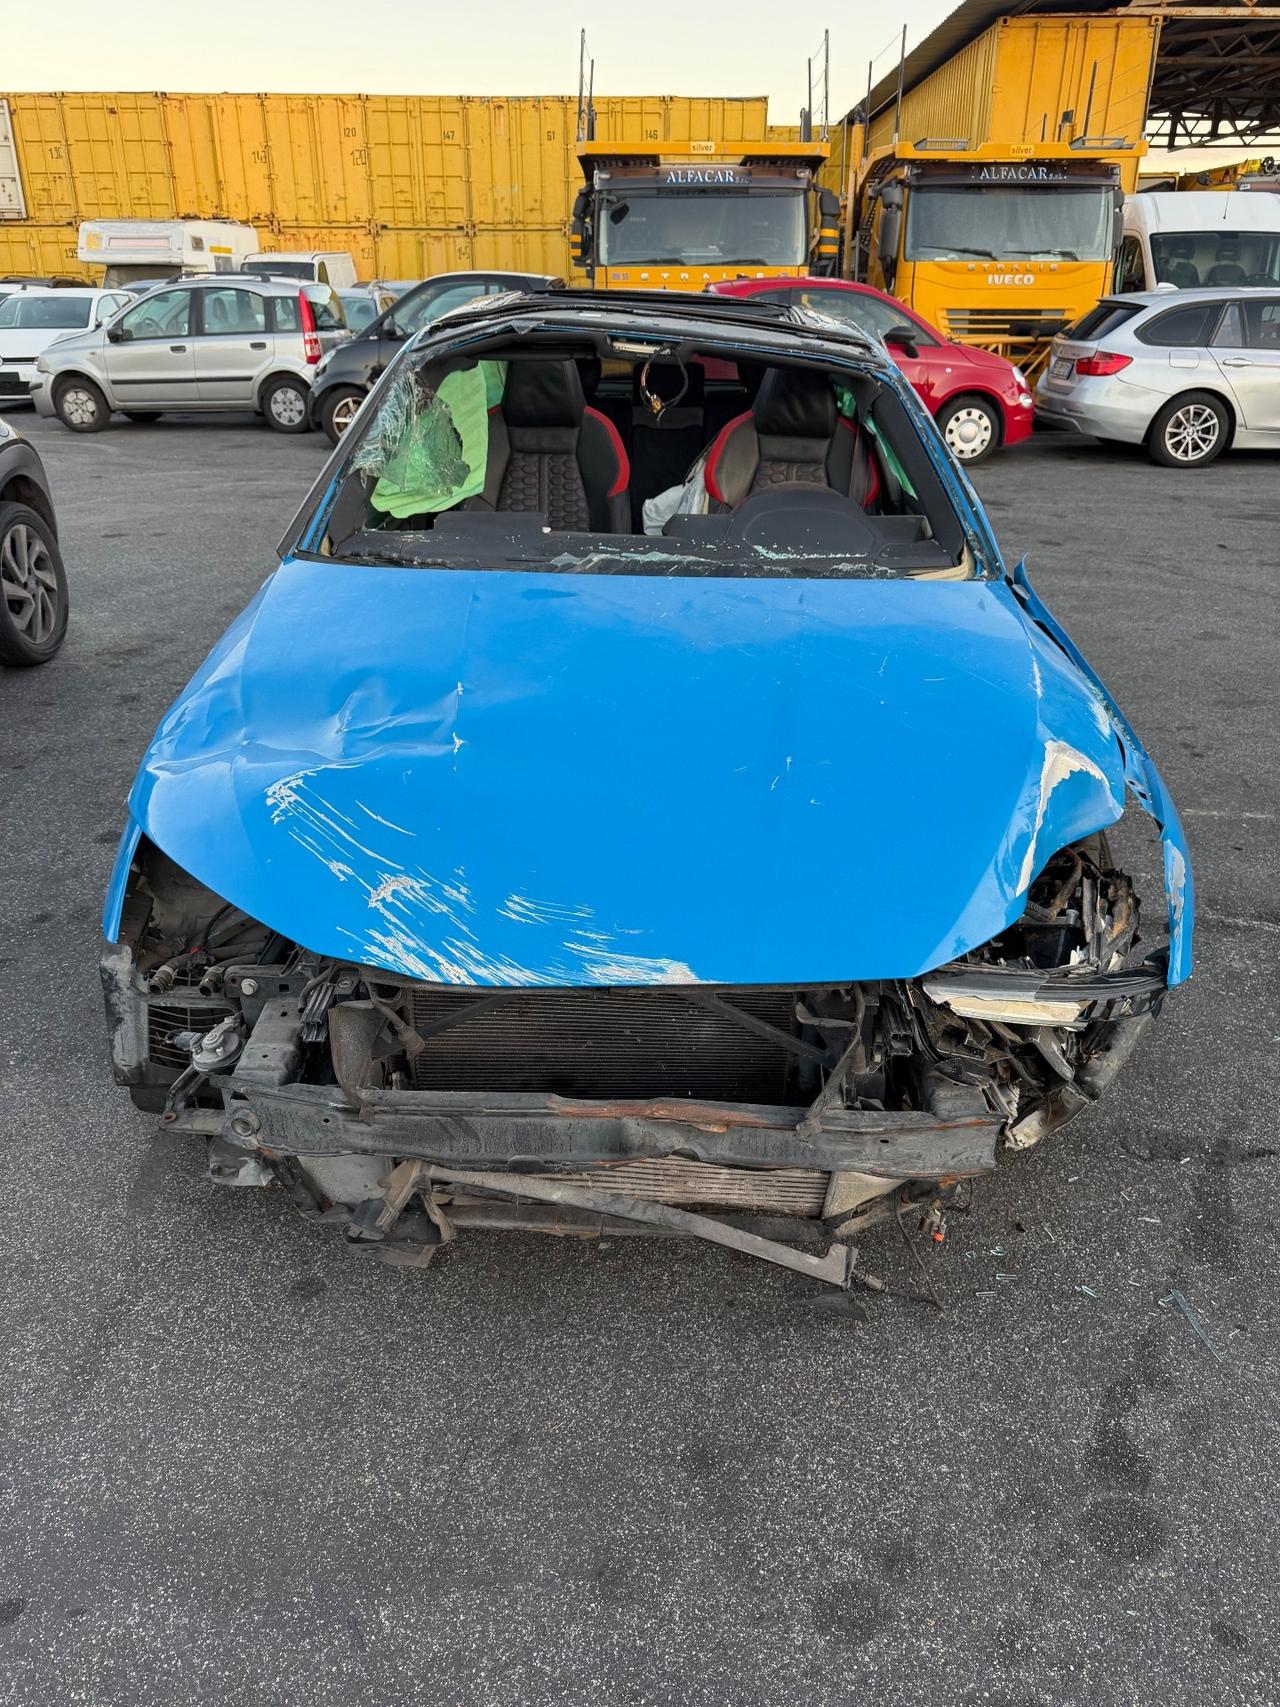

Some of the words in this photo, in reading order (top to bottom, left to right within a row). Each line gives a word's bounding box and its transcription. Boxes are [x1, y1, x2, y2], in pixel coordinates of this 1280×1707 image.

[343, 127, 357, 138] 120
[442, 130, 455, 141] 147
[691, 144, 713, 152] silver
[1011, 146, 1032, 155] silver
[667, 170, 734, 183] ALFACAR
[980, 167, 1047, 180] ALFACAR
[988, 274, 1035, 286] IVECO
